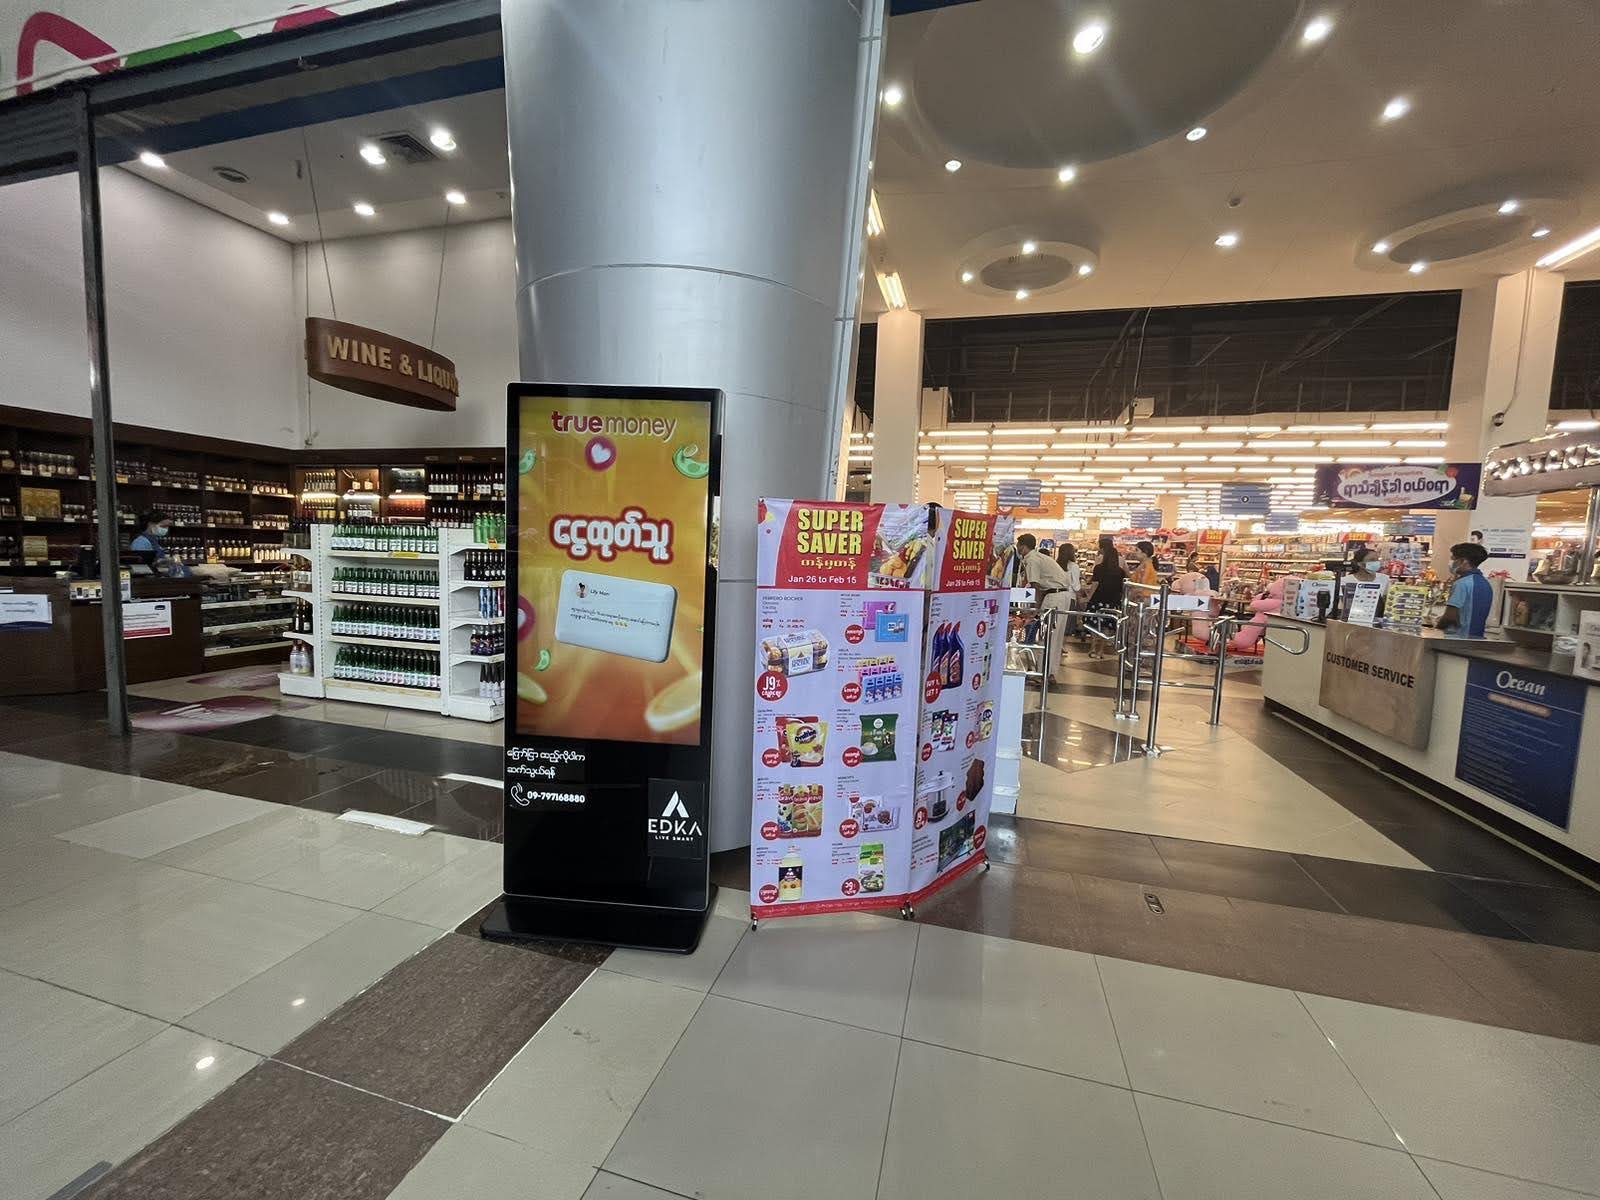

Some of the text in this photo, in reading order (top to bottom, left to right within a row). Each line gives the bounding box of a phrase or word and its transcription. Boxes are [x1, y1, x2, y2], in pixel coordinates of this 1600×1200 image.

[327, 335, 393, 370] WINE
[399, 354, 413, 376] &
[797, 508, 864, 532] SUPER
[954, 518, 988, 540] SUPER
[551, 508, 672, 562] ငွေထုတ်သူ
[797, 532, 862, 555] SAVER
[953, 541, 985, 560] SAVER
[787, 575, 804, 584] Jan
[806, 575, 817, 583] 26
[818, 575, 827, 583] to
[829, 575, 845, 584] Feb
[1326, 651, 1415, 689] CUSTOMER SERVICE
[1495, 670, 1547, 697] Ocean
[506, 764, 556, 779] ဆက်သွယ်ရန်
[527, 790, 585, 804] 09-797168880
